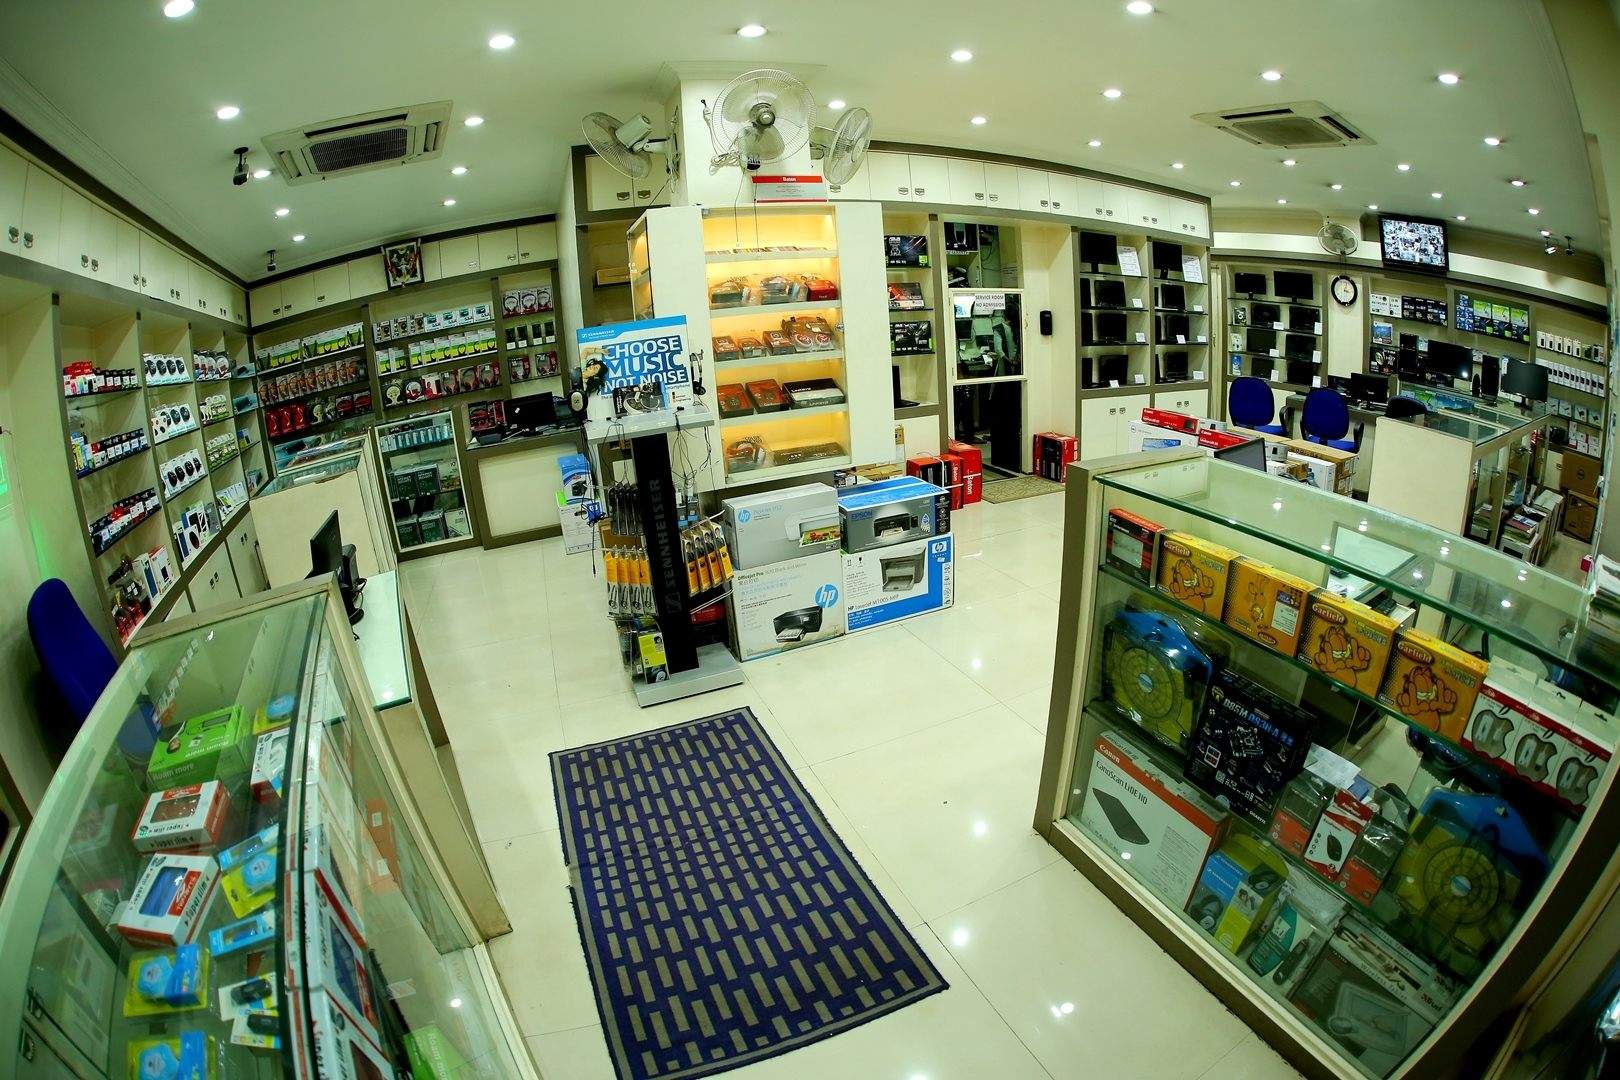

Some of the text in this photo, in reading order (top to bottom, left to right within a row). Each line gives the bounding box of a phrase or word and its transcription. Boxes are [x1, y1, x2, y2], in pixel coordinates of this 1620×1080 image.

[602, 336, 681, 360] CHOOSE
[603, 350, 686, 379] MUSIC
[603, 376, 637, 394] NOT
[639, 369, 687, 386] NOISE
[851, 509, 873, 520] EPSON
[649, 478, 676, 589] SENNHEISER
[1163, 540, 1191, 557] Garfield
[817, 584, 836, 608] hp
[1313, 603, 1345, 623] Garfield
[1398, 641, 1432, 663] Garfield
[1099, 745, 1121, 765] Canon
[1096, 760, 1125, 790] CanoScan
[1124, 782, 1139, 799] LiDE
[185, 894, 201, 921] Super
[198, 880, 210, 900] slim
